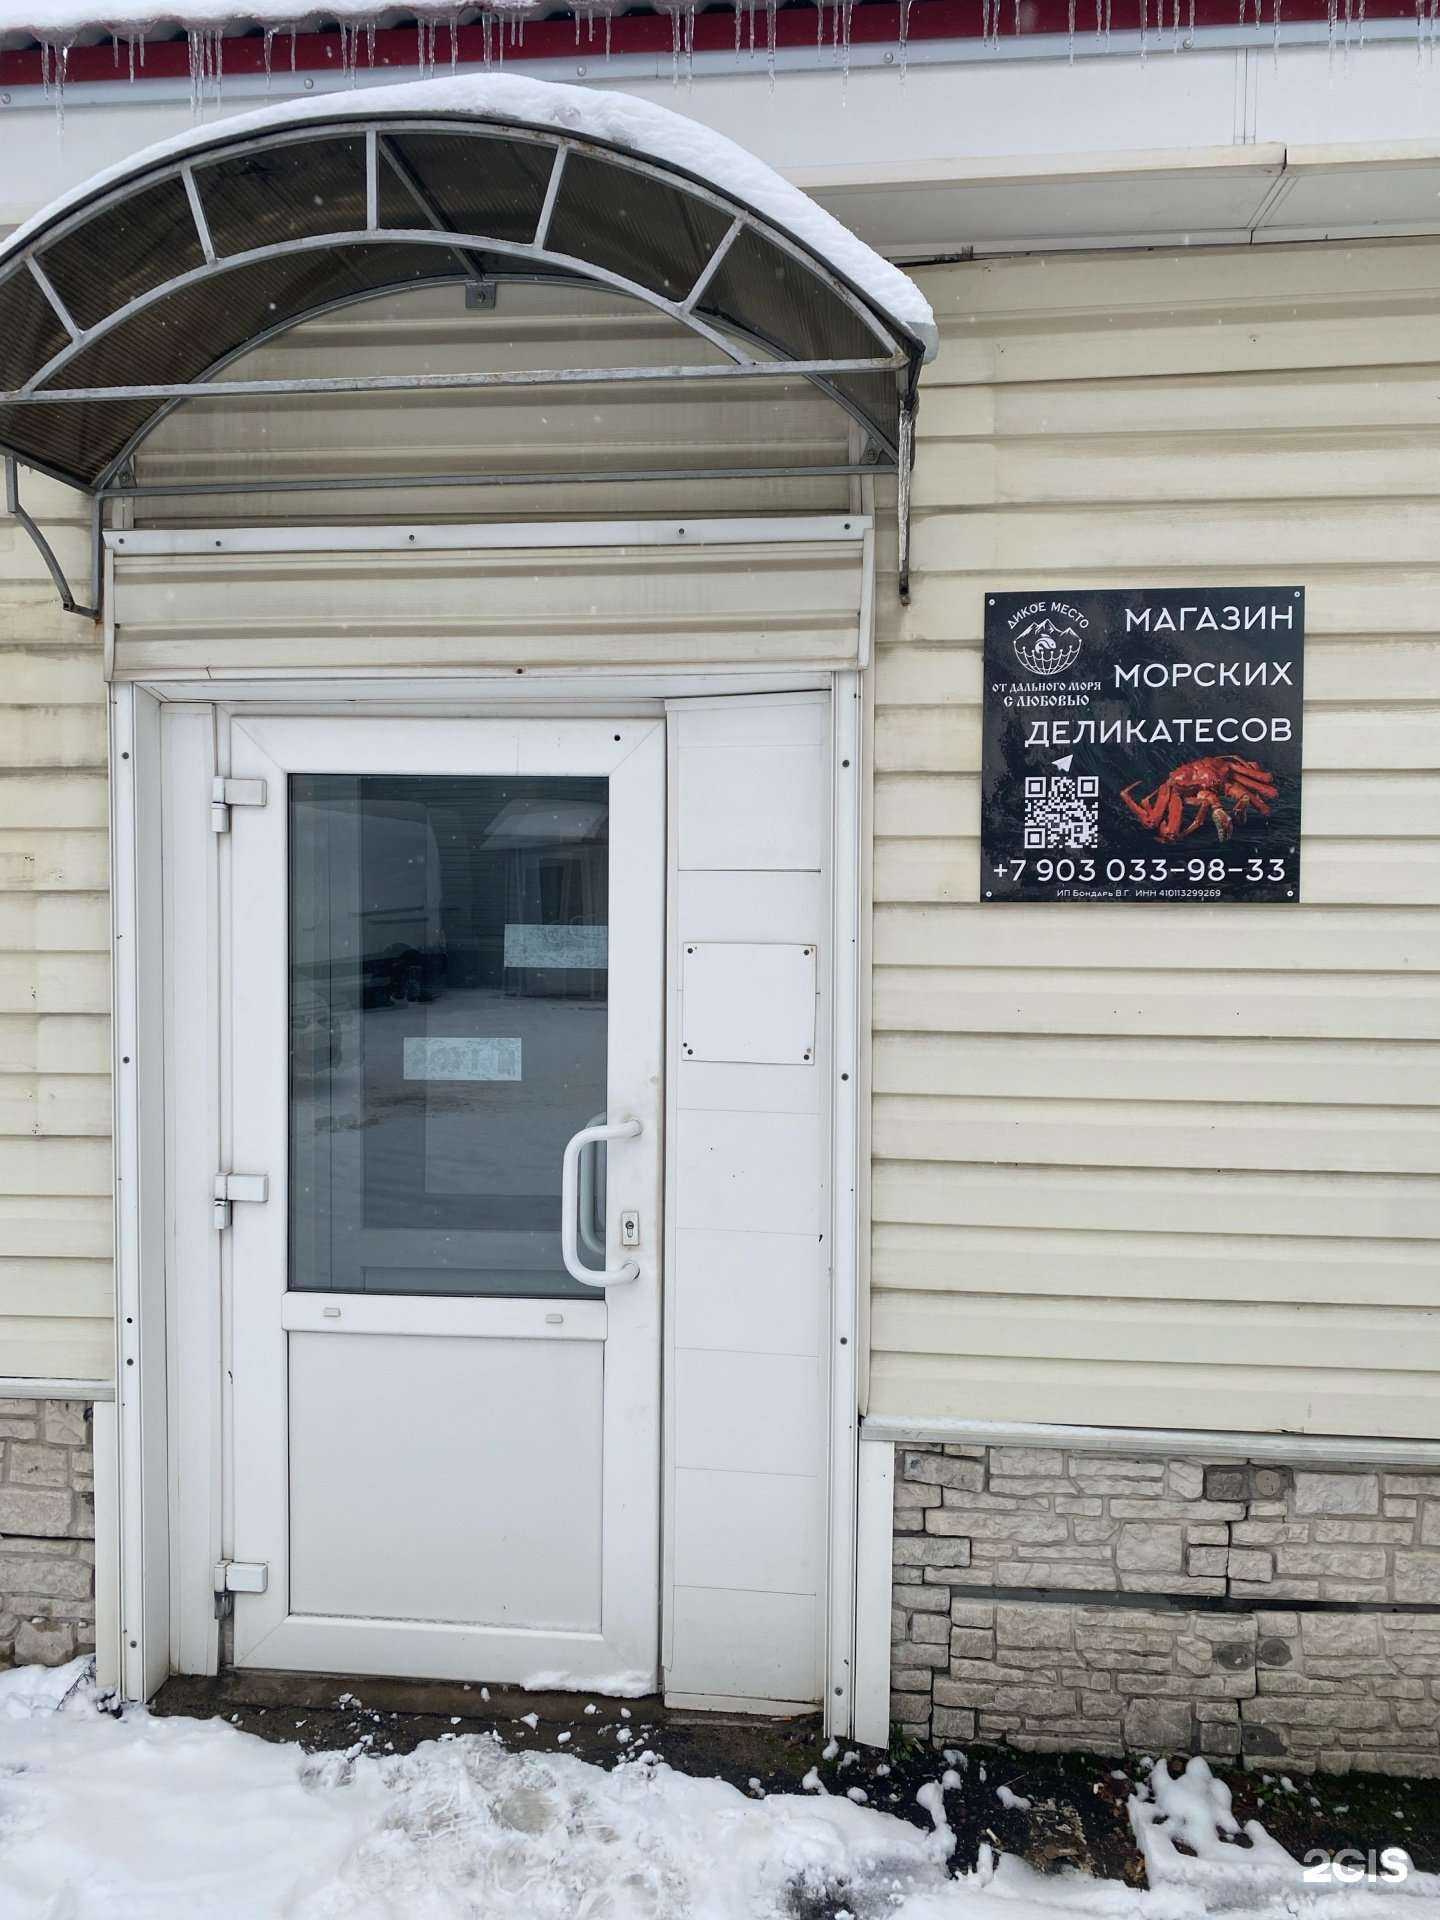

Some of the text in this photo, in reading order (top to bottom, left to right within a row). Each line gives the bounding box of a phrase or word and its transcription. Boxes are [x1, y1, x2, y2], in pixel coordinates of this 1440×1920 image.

[1007, 601, 1090, 630] ДИКОЕ МЕСТО
[1125, 605, 1294, 632] МАГАЗИН
[992, 681, 1102, 693] ОТ ДАЛЬНОГО МОРЯ
[1114, 662, 1294, 688] МОРСКИХ
[1003, 694, 1090, 708] С ЛЮБОВЬЮ
[1024, 717, 1293, 747] ДЕЛИКАТЕСОВ
[993, 858, 1286, 881] +7 903 033-98-33
[1056, 889, 1071, 897] ИП
[1072, 889, 1114, 898] Бондарь
[1135, 889, 1157, 897] ИНН
[1159, 889, 1221, 897] 410113299269
